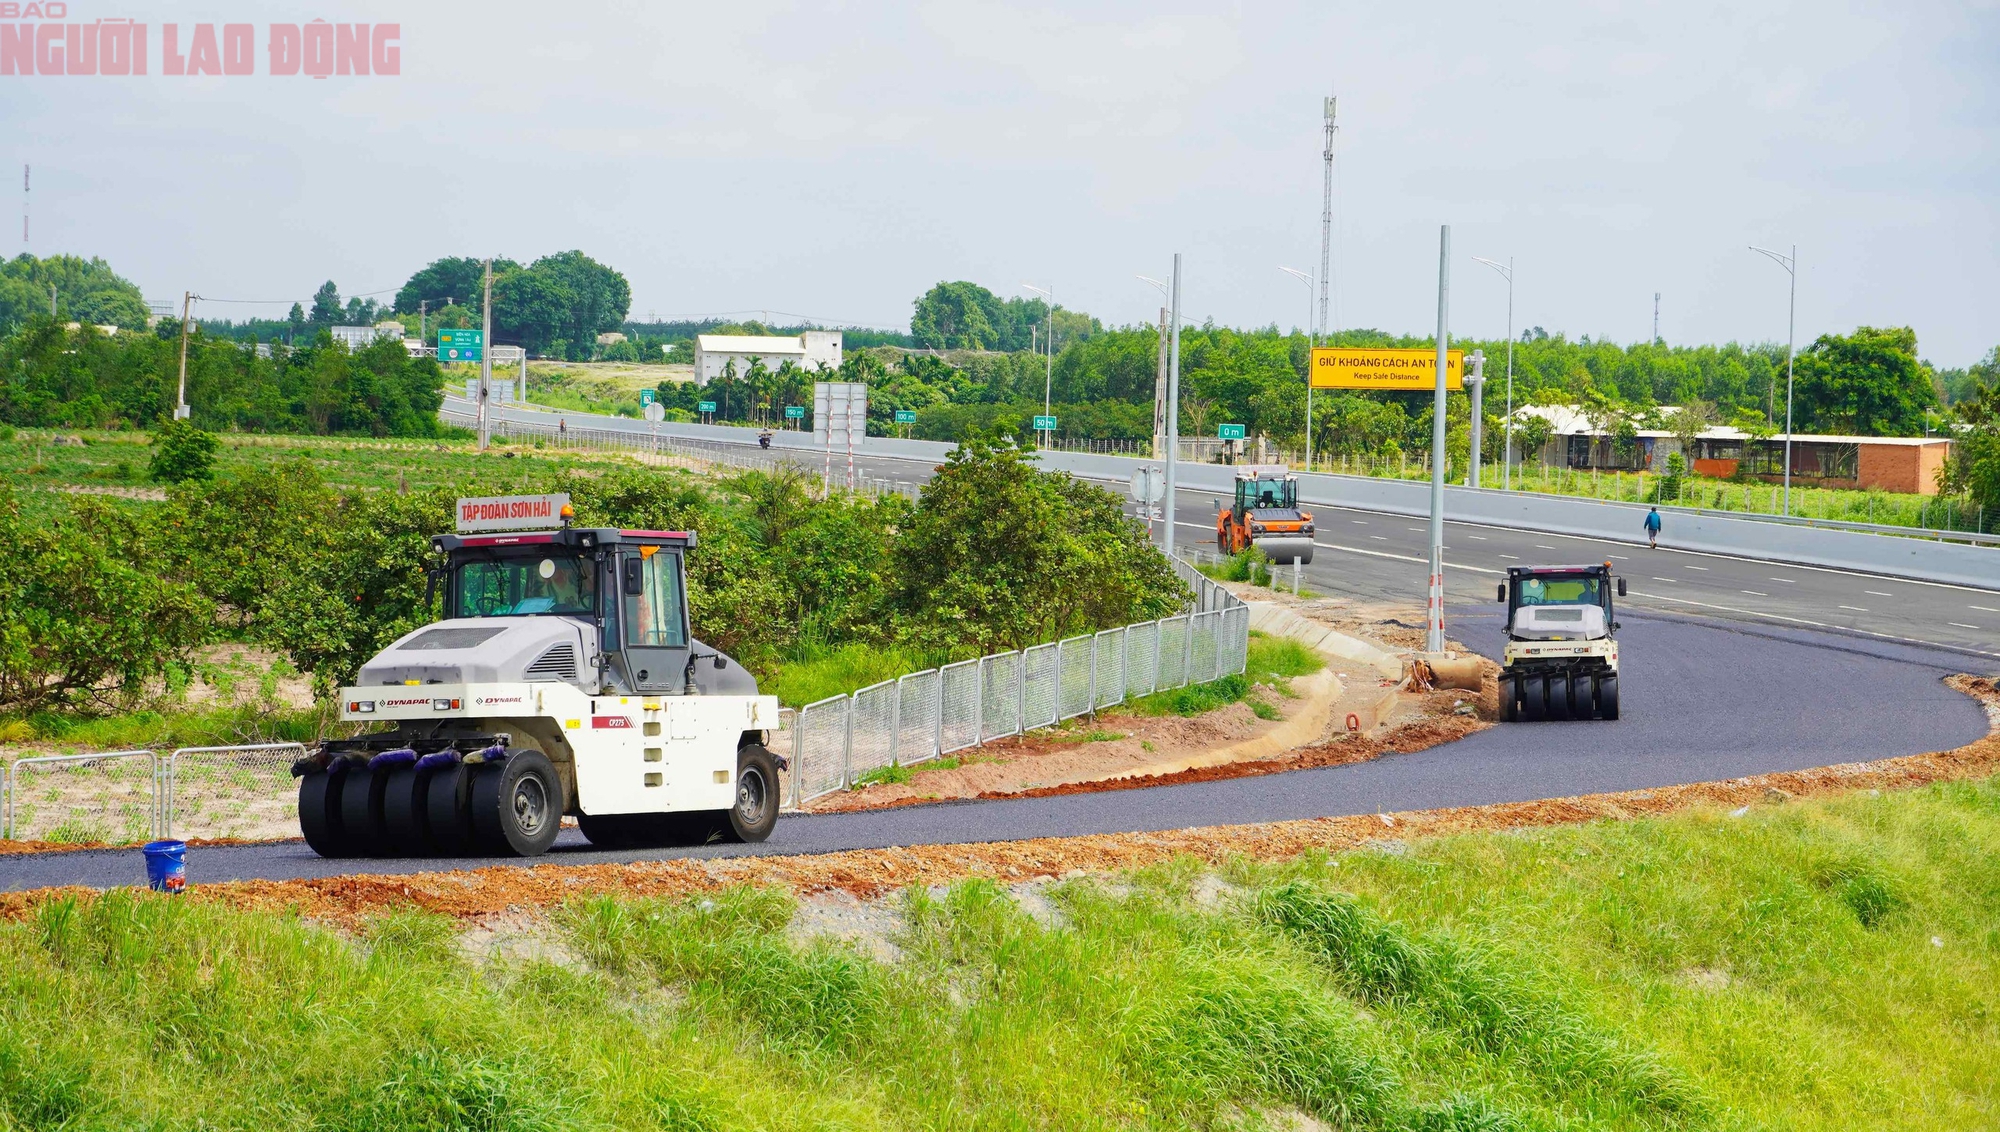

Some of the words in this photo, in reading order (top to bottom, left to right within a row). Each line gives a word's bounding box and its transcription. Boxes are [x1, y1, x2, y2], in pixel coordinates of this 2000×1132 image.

[1319, 356, 1337, 367] GIỮ
[1338, 355, 1381, 367] KHOẢNG
[1382, 356, 1409, 368] CÁCH
[1411, 359, 1426, 368] AN
[1429, 359, 1455, 368] TN
[1354, 372, 1372, 380] Keep
[462, 502, 480, 522] TẬP
[481, 500, 508, 520] ĐOÀN
[511, 500, 532, 518] SƠN
[534, 496, 551, 517] HẢI
